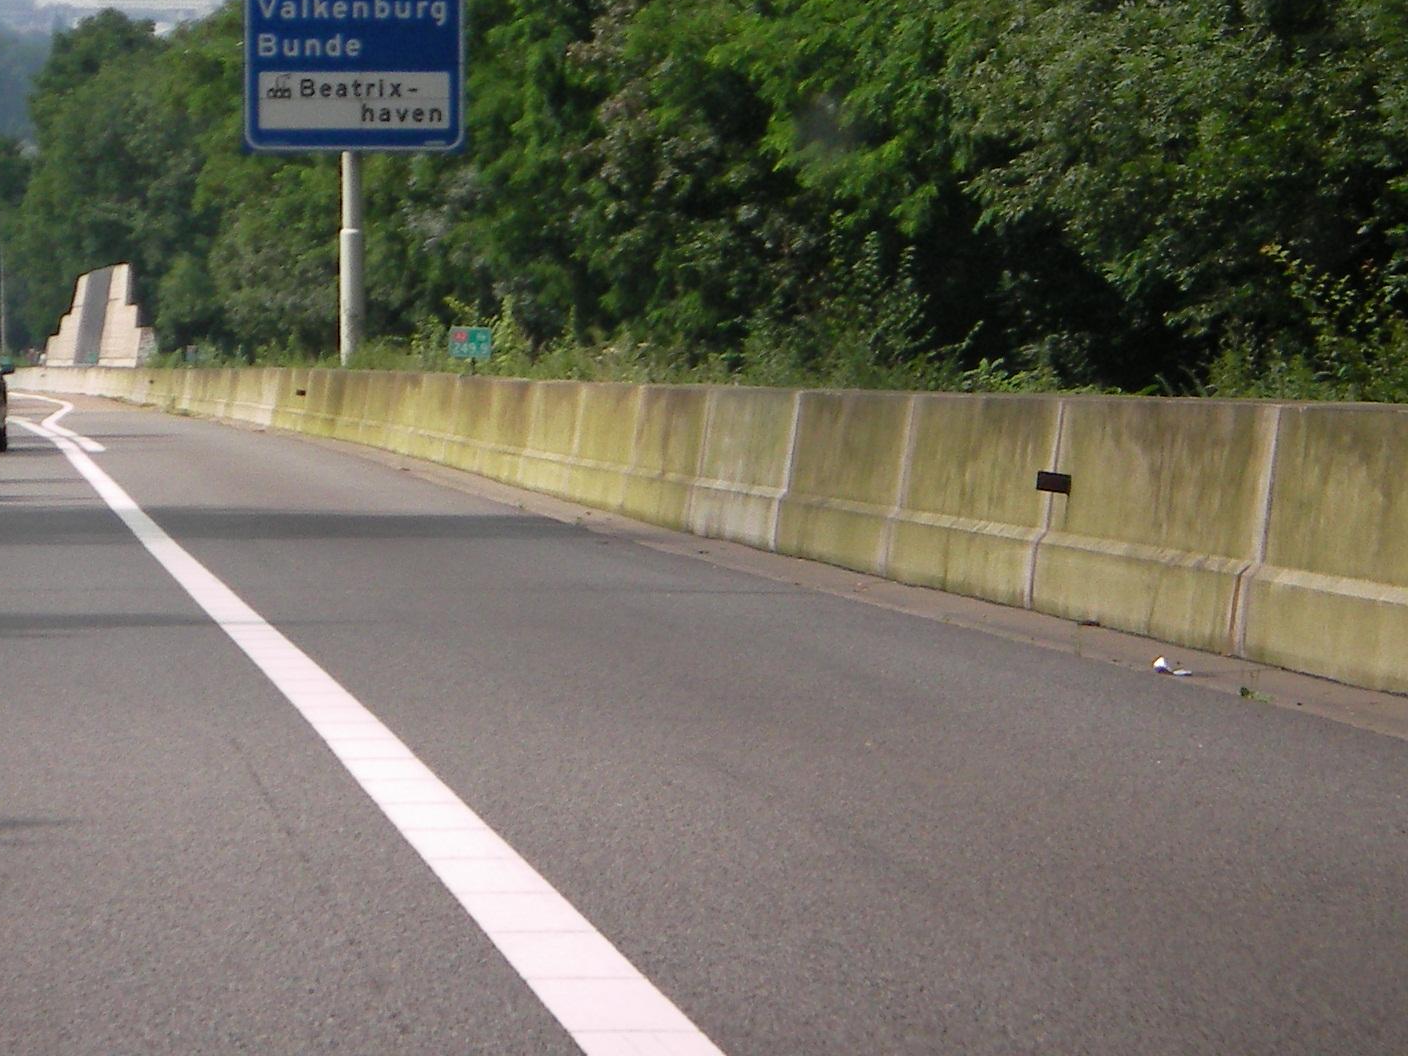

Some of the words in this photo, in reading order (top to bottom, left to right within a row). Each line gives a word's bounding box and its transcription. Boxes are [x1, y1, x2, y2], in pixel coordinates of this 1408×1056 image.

[258, 33, 361, 57] Bunde
[299, 78, 419, 98] Beatrix-
[360, 103, 442, 123] haven
